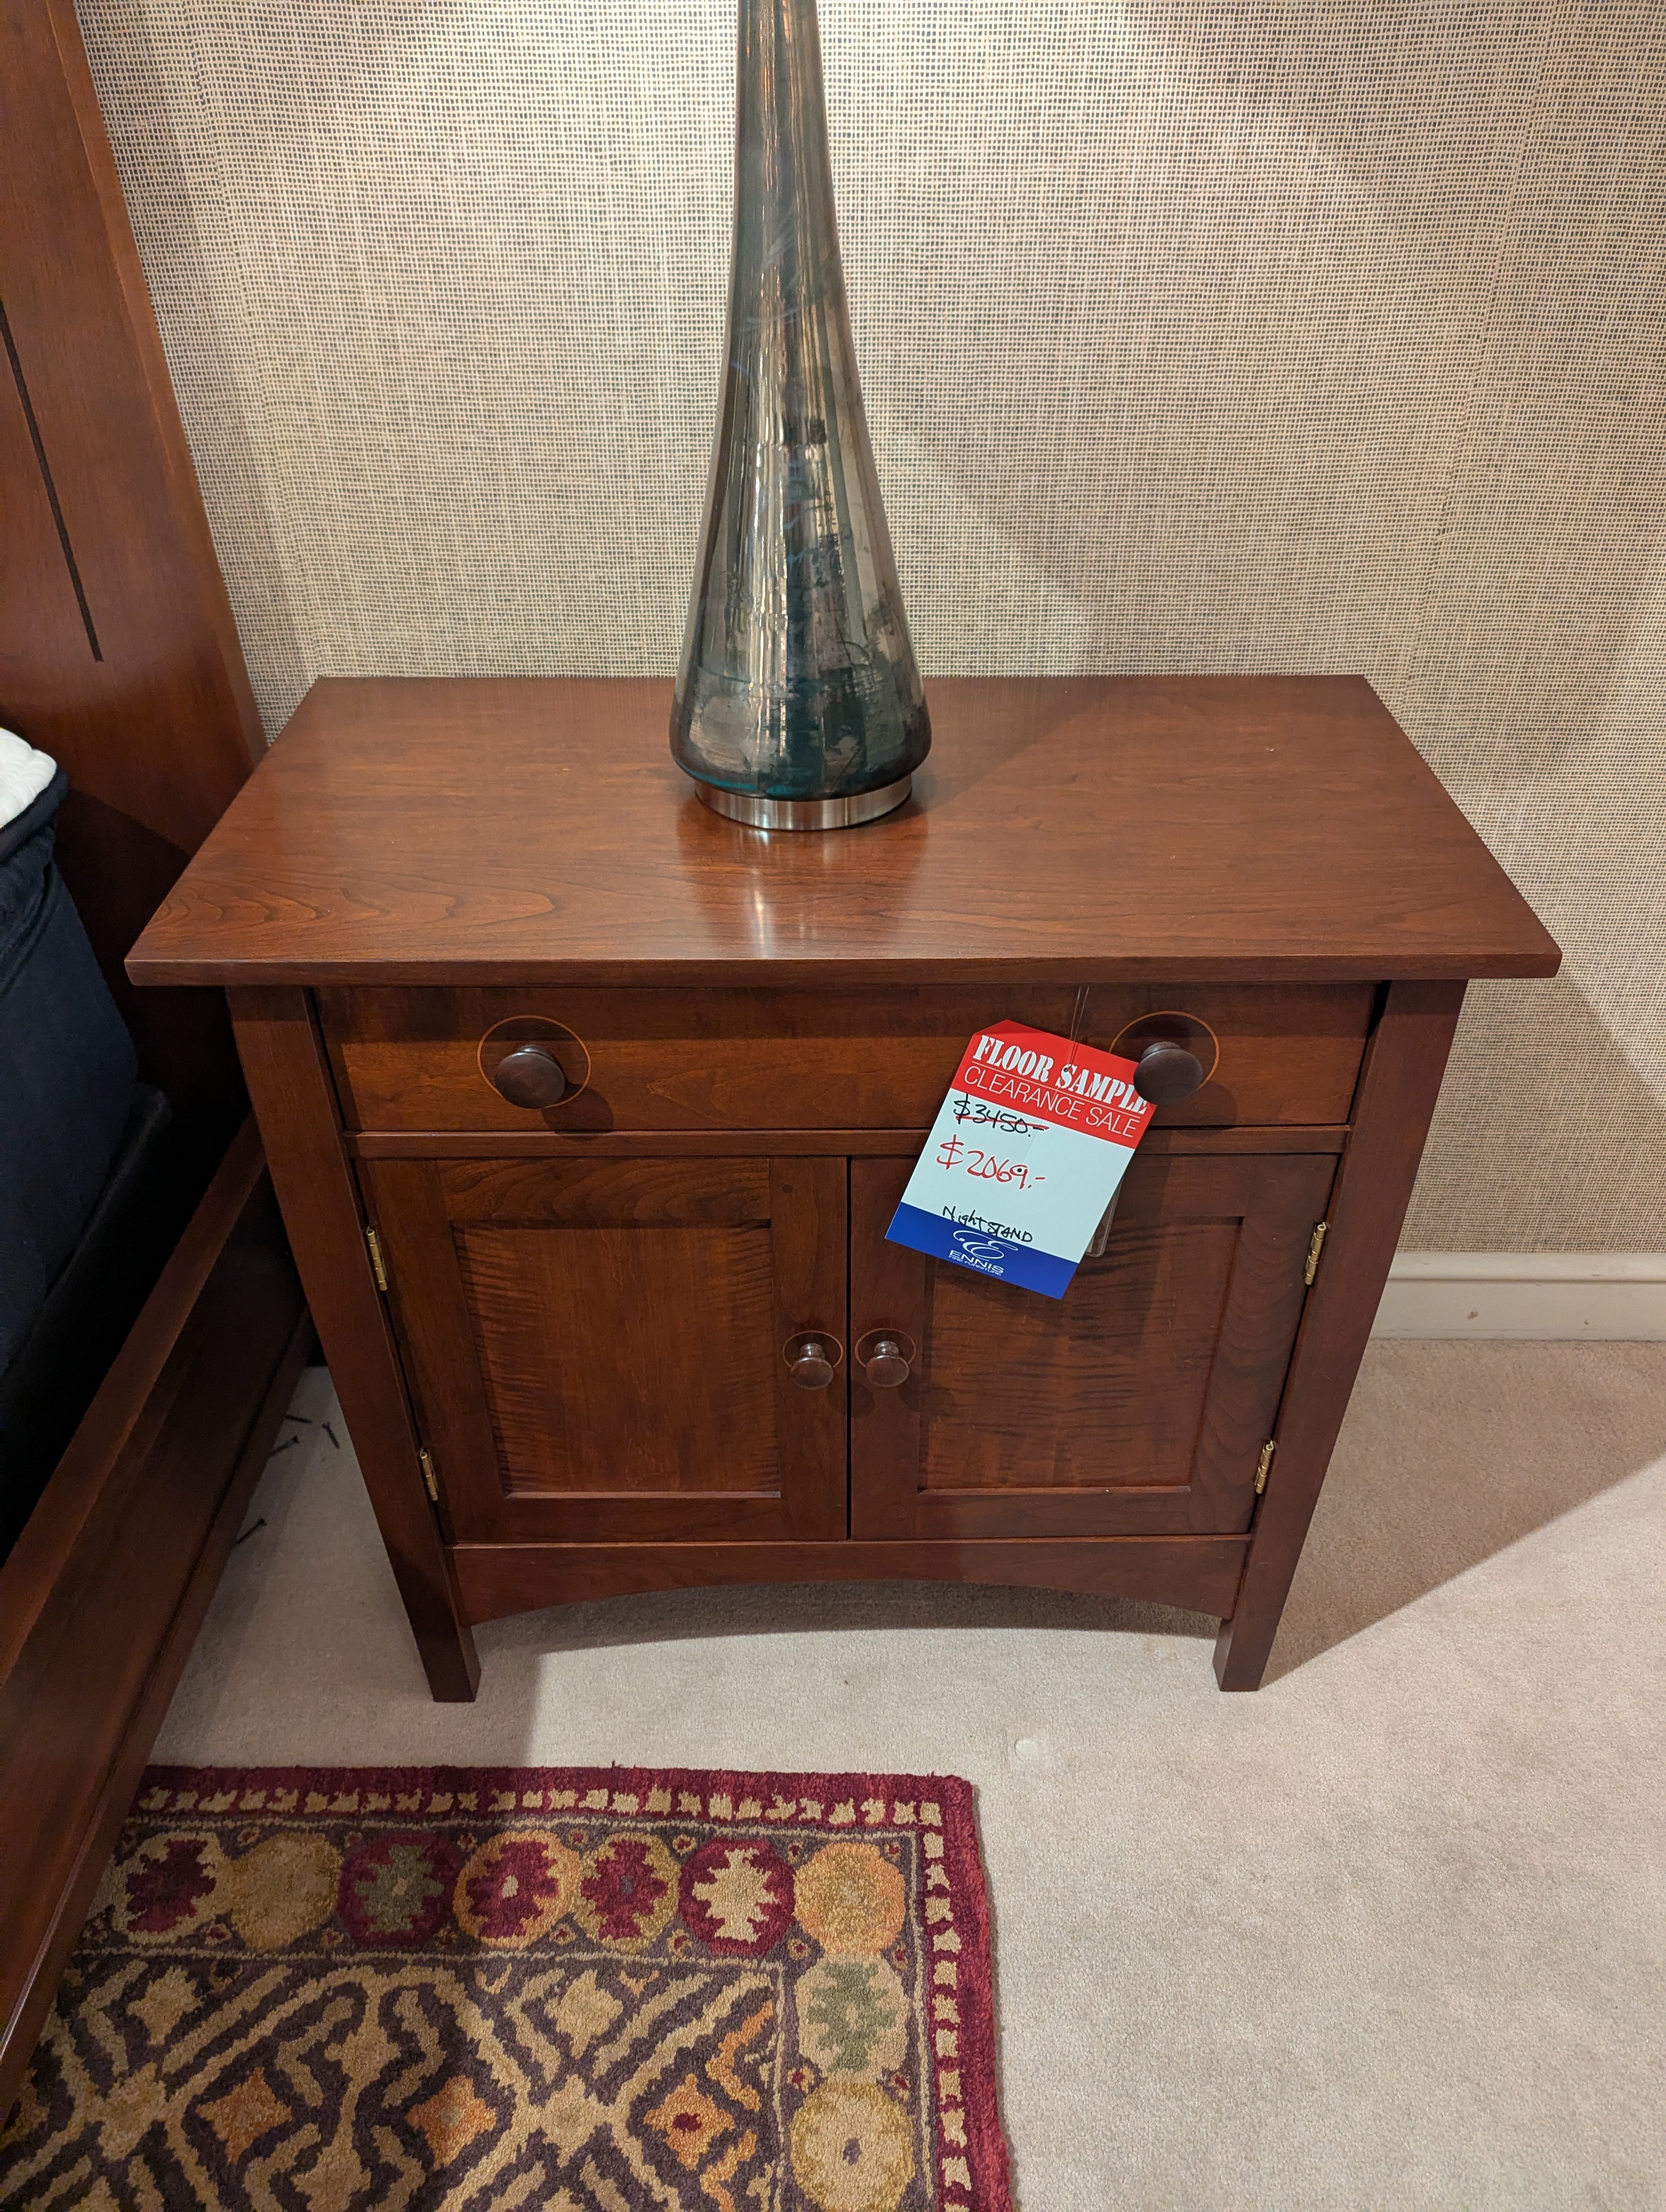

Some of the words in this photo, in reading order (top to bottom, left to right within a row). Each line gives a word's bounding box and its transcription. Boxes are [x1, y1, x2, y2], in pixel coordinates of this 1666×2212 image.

[973, 1035, 1054, 1082] FLOOR
[1055, 1064, 1148, 1115] SAMPLE
[965, 1066, 1085, 1120] CLEARANCE
[1086, 1107, 1140, 1137] SALE
[950, 1250, 1004, 1274] ENNIS
[965, 1261, 1002, 1276] FURNITURE
